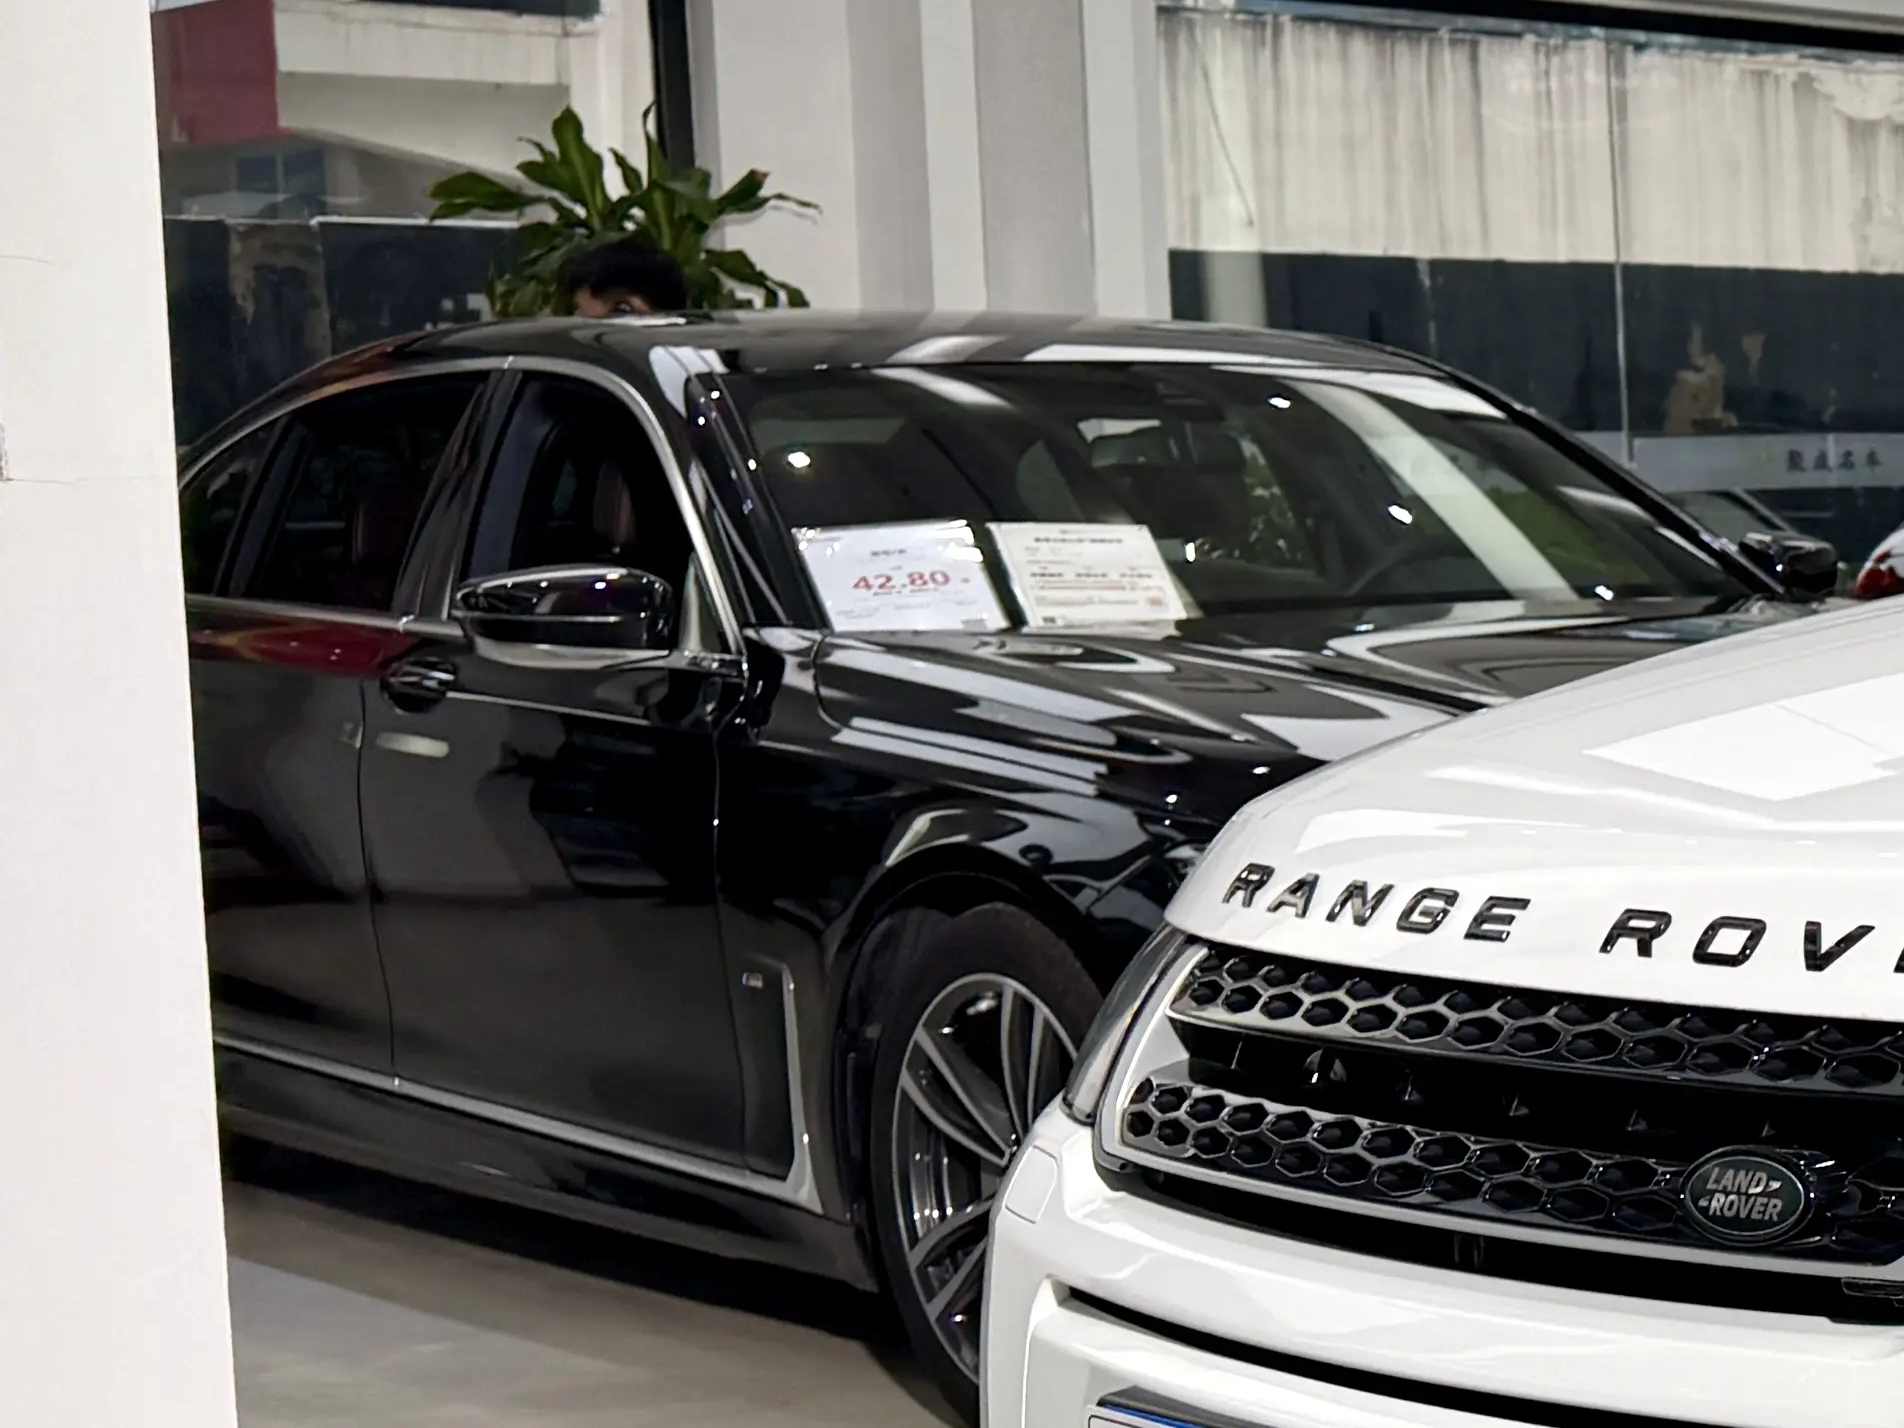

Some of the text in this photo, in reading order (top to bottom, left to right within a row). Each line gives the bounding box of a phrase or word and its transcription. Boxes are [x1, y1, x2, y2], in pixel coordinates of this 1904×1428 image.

[852, 570, 951, 591] 42.80
[1221, 861, 1531, 945] RANGE
[1705, 1166, 1769, 1195] LAND
[1708, 1192, 1783, 1222] ROVER
